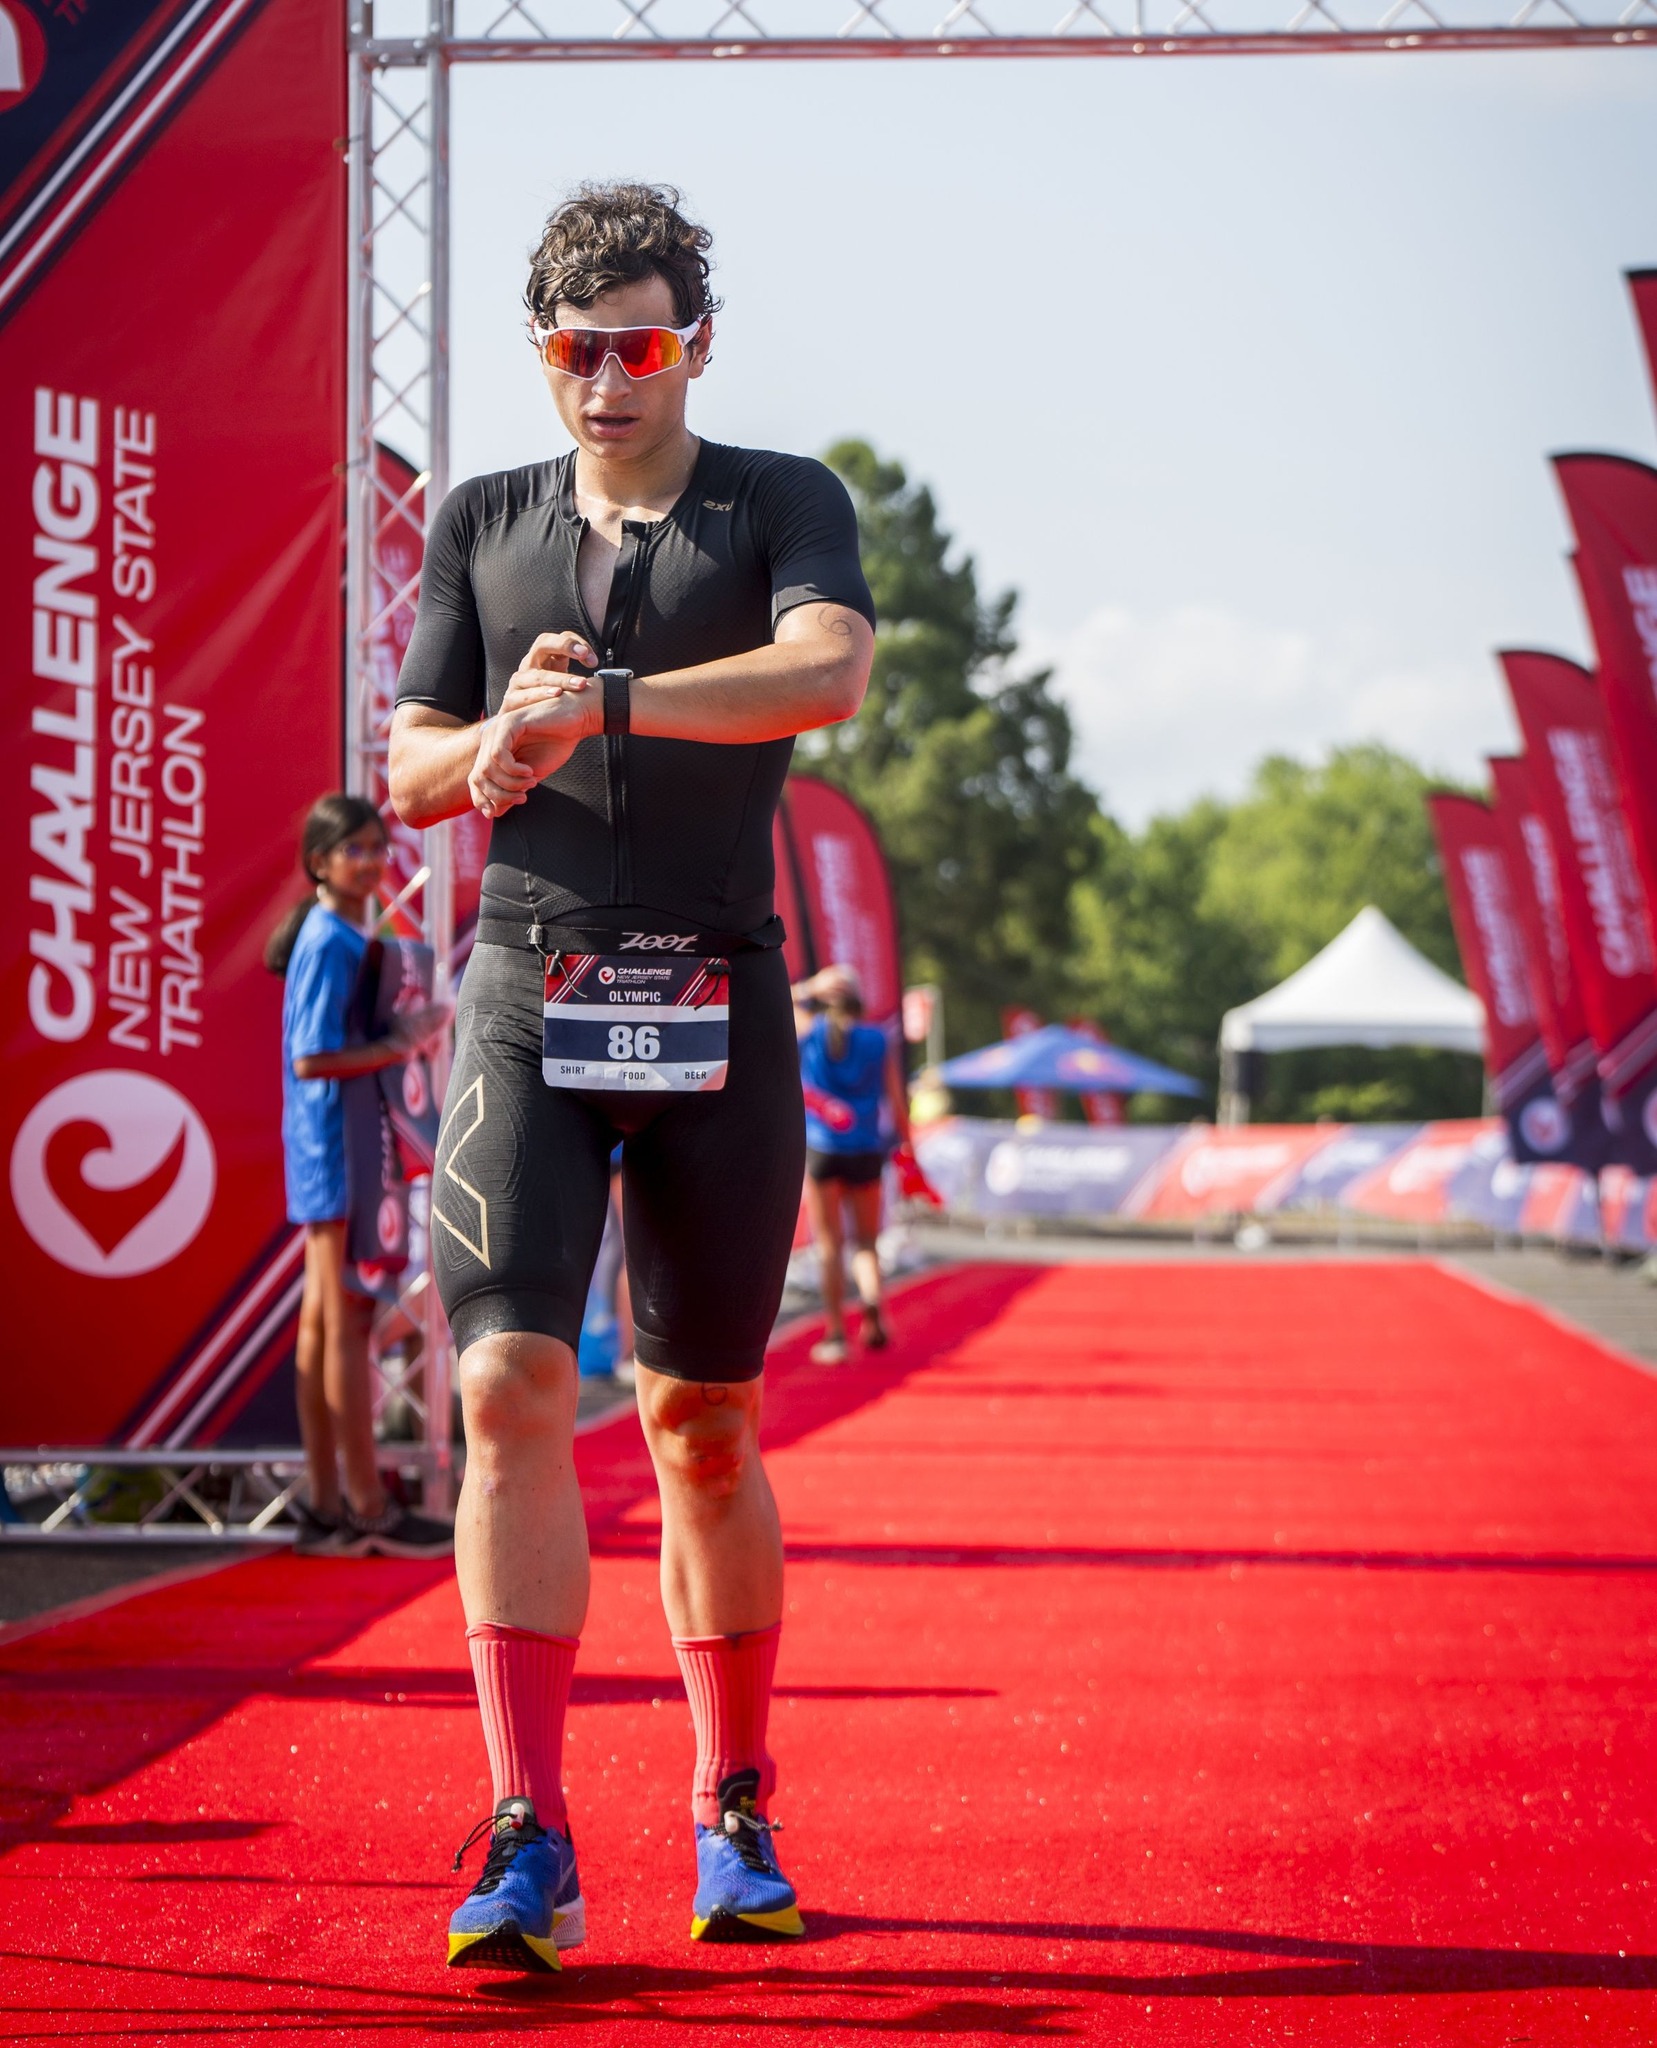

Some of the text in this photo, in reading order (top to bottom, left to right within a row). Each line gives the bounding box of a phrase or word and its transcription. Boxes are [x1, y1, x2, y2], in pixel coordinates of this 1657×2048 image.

[702, 500, 734, 511] 2XU
[27, 386, 100, 1043] CHALLENGE
[107, 404, 156, 1052] NEW JERSEY STATE
[159, 703, 207, 1057] TRIATHLON
[617, 967, 673, 976] CHALLENGE
[608, 990, 661, 1003] OLYMPIC
[607, 1025, 660, 1060] 86
[560, 1065, 707, 1080] SHIRT FOOD BEER
